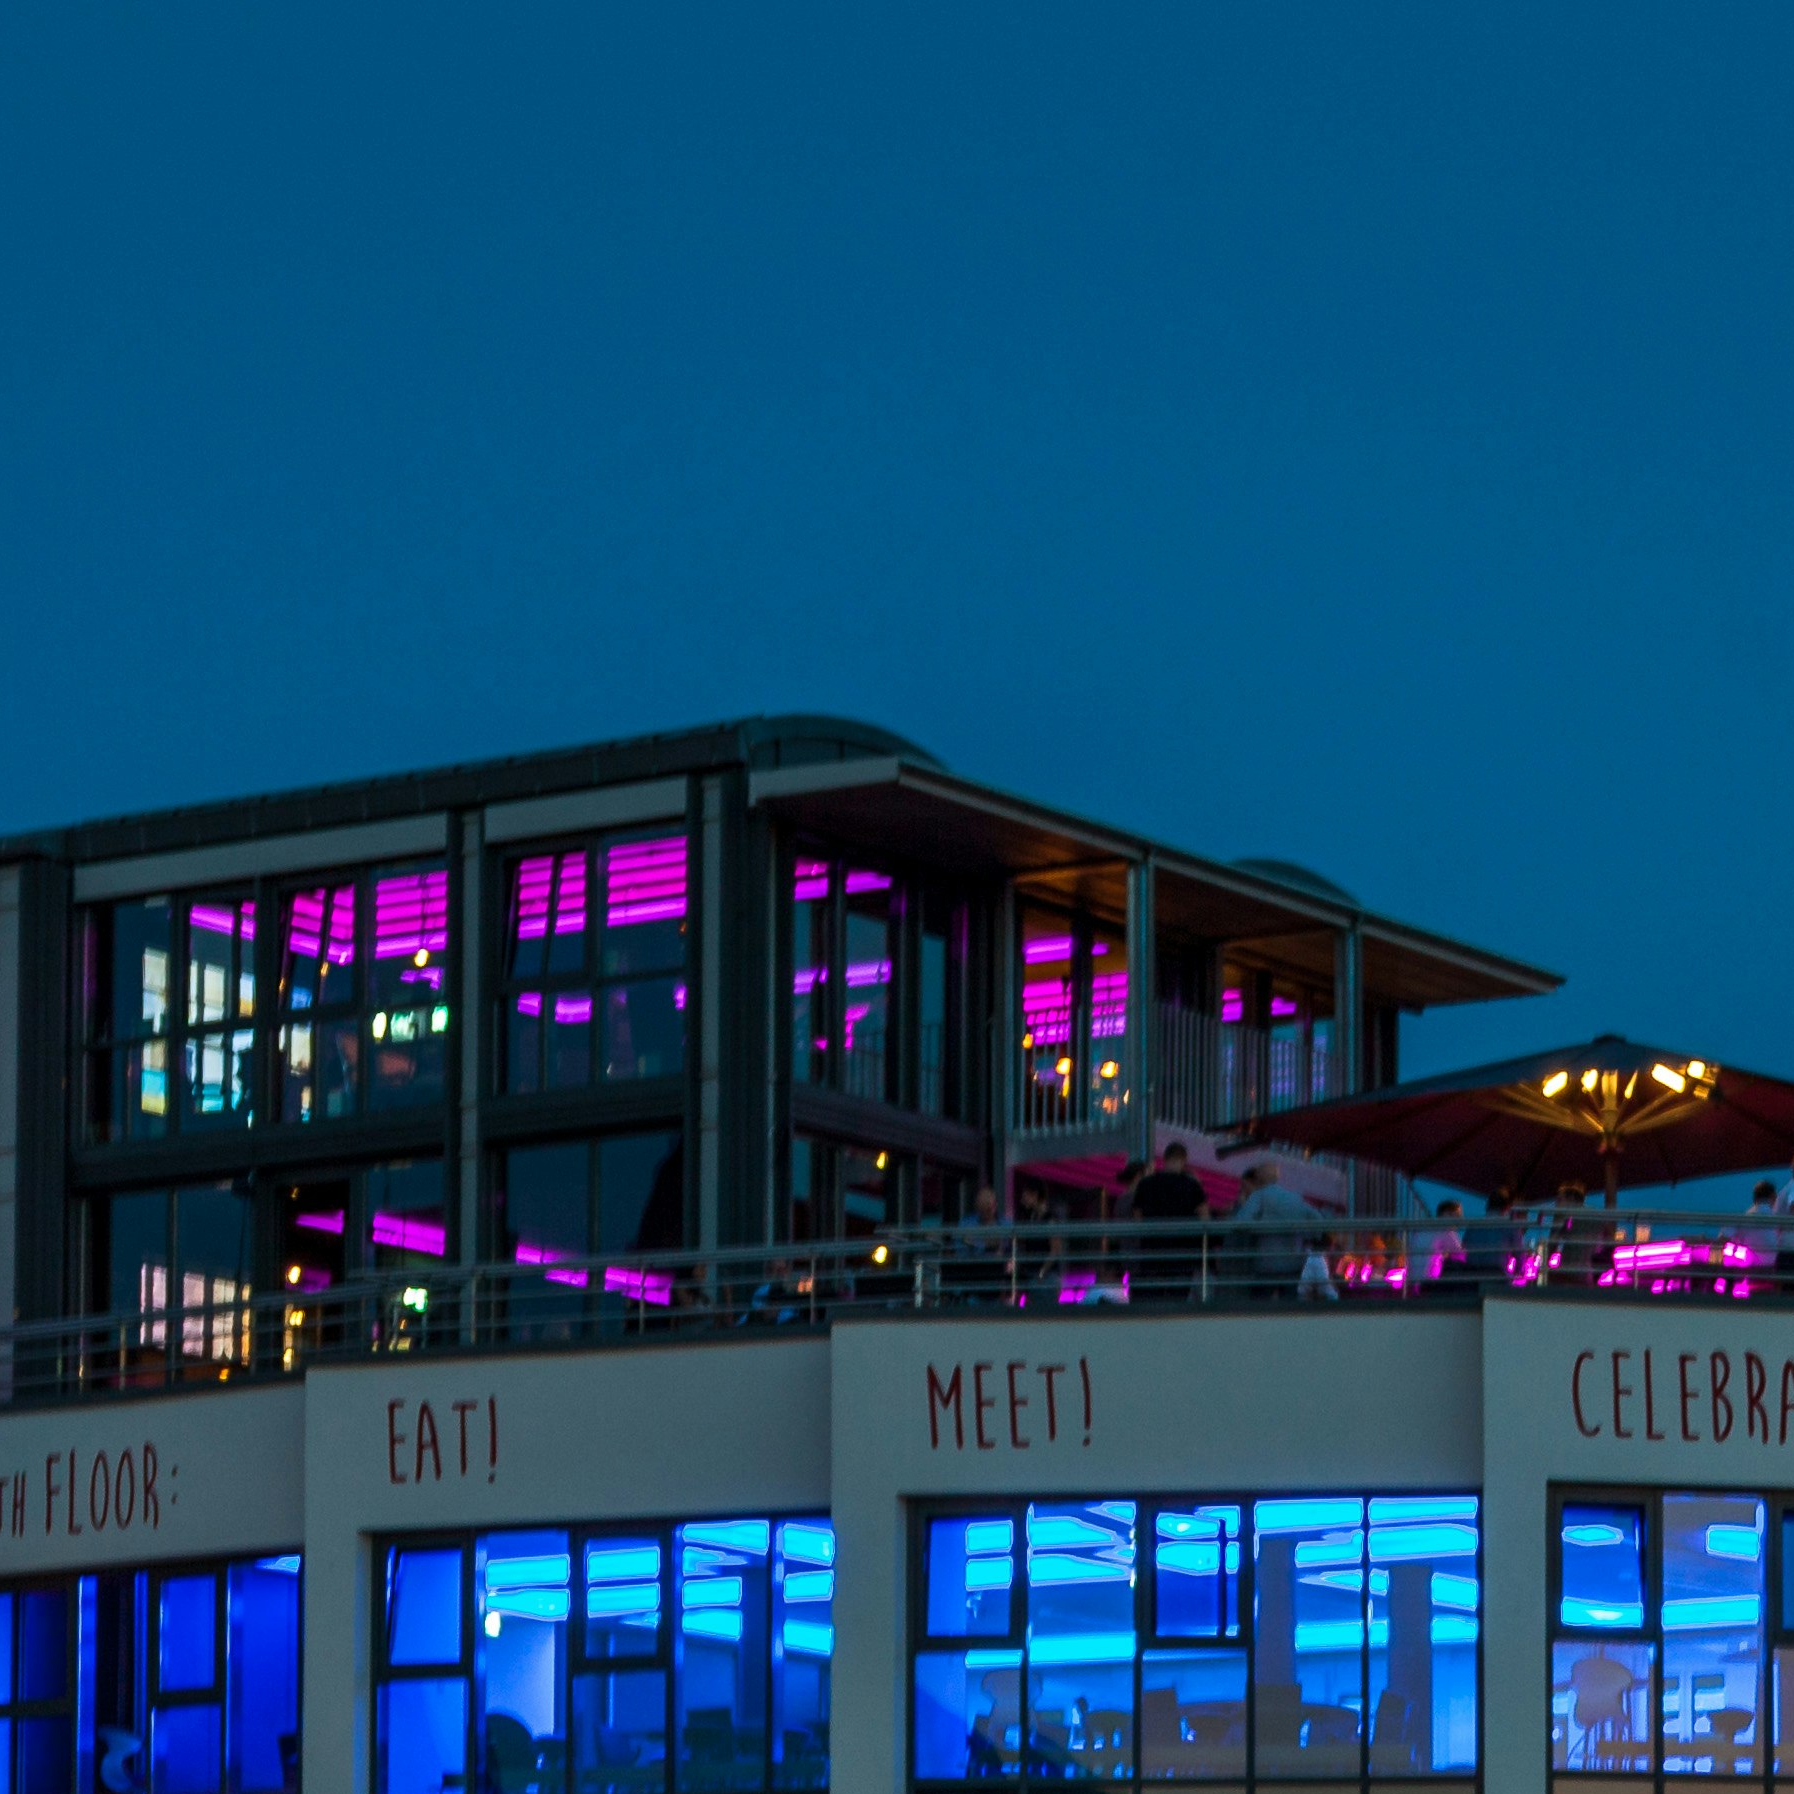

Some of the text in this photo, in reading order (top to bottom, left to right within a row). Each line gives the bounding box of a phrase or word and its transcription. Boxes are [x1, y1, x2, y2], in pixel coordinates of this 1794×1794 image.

[387, 1394, 498, 1485] EAT!
[926, 1355, 1092, 1450] MEET!
[45, 1439, 179, 1537] FLOOR:
